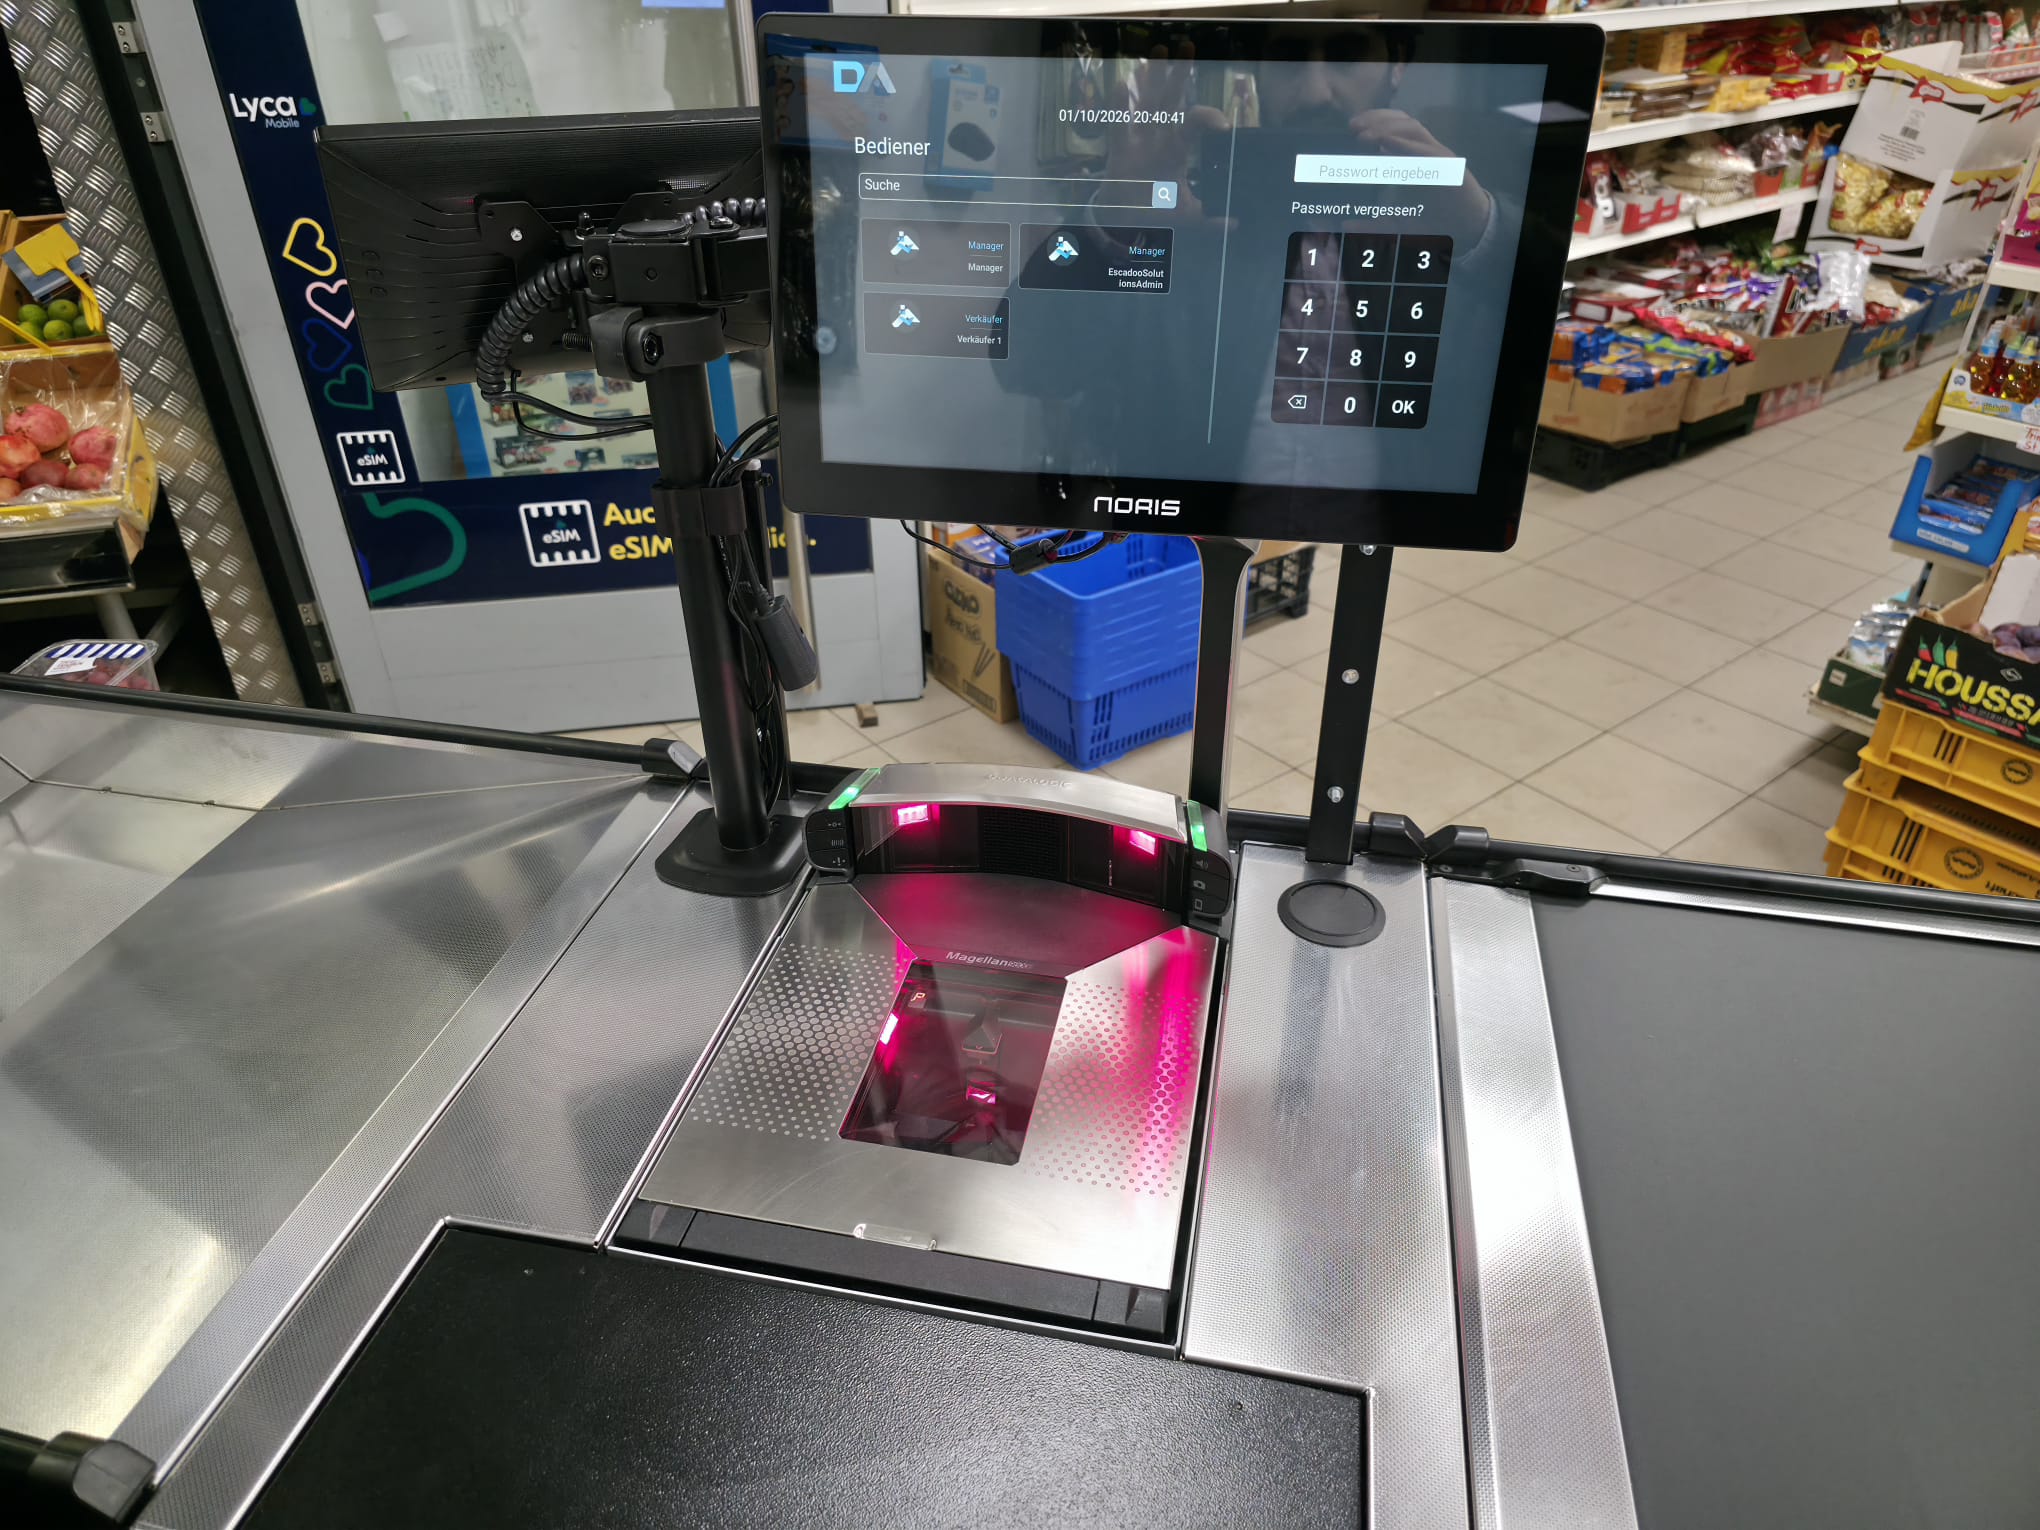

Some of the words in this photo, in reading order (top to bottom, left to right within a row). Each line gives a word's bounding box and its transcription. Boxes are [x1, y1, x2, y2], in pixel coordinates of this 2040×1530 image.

[229, 93, 298, 122] Lyca
[265, 117, 300, 128] Mobile
[1059, 109, 1131, 122] 01/10/2026
[1133, 111, 1185, 124] 20:40:41
[854, 136, 931, 155] Bediener
[1319, 165, 1379, 179] Passwort
[1382, 166, 1440, 181] eingeben
[864, 178, 901, 191] Suche
[1291, 201, 1351, 216] Passwort
[1353, 204, 1424, 219] vergessen?
[968, 241, 1004, 252] Manager
[1129, 246, 1166, 257] Manager
[1307, 249, 1317, 266] 1
[1361, 249, 1375, 268] 2
[1417, 251, 1431, 269] 3
[968, 263, 1004, 274] Manager
[1108, 267, 1165, 278] EscadooSolut
[1118, 279, 1163, 289] ionsAdmin
[1300, 298, 1314, 316] 4
[1355, 300, 1369, 318] 5
[1410, 302, 1424, 320] 6
[965, 314, 1003, 324] Verkäufer
[957, 334, 996, 344] Verkäufer
[997, 337, 1002, 345] 1
[1296, 347, 1309, 365] 7
[1350, 349, 1362, 366] 8
[1404, 351, 1417, 368] 9
[1344, 396, 1356, 414] 0
[1391, 400, 1416, 415] OK
[357, 454, 388, 466] eSIM
[603, 502, 656, 527] Auc
[1093, 496, 1181, 516] NORIS
[542, 529, 581, 544] eSIM
[609, 534, 674, 561] eSIM
[945, 951, 1009, 967] Magellan
